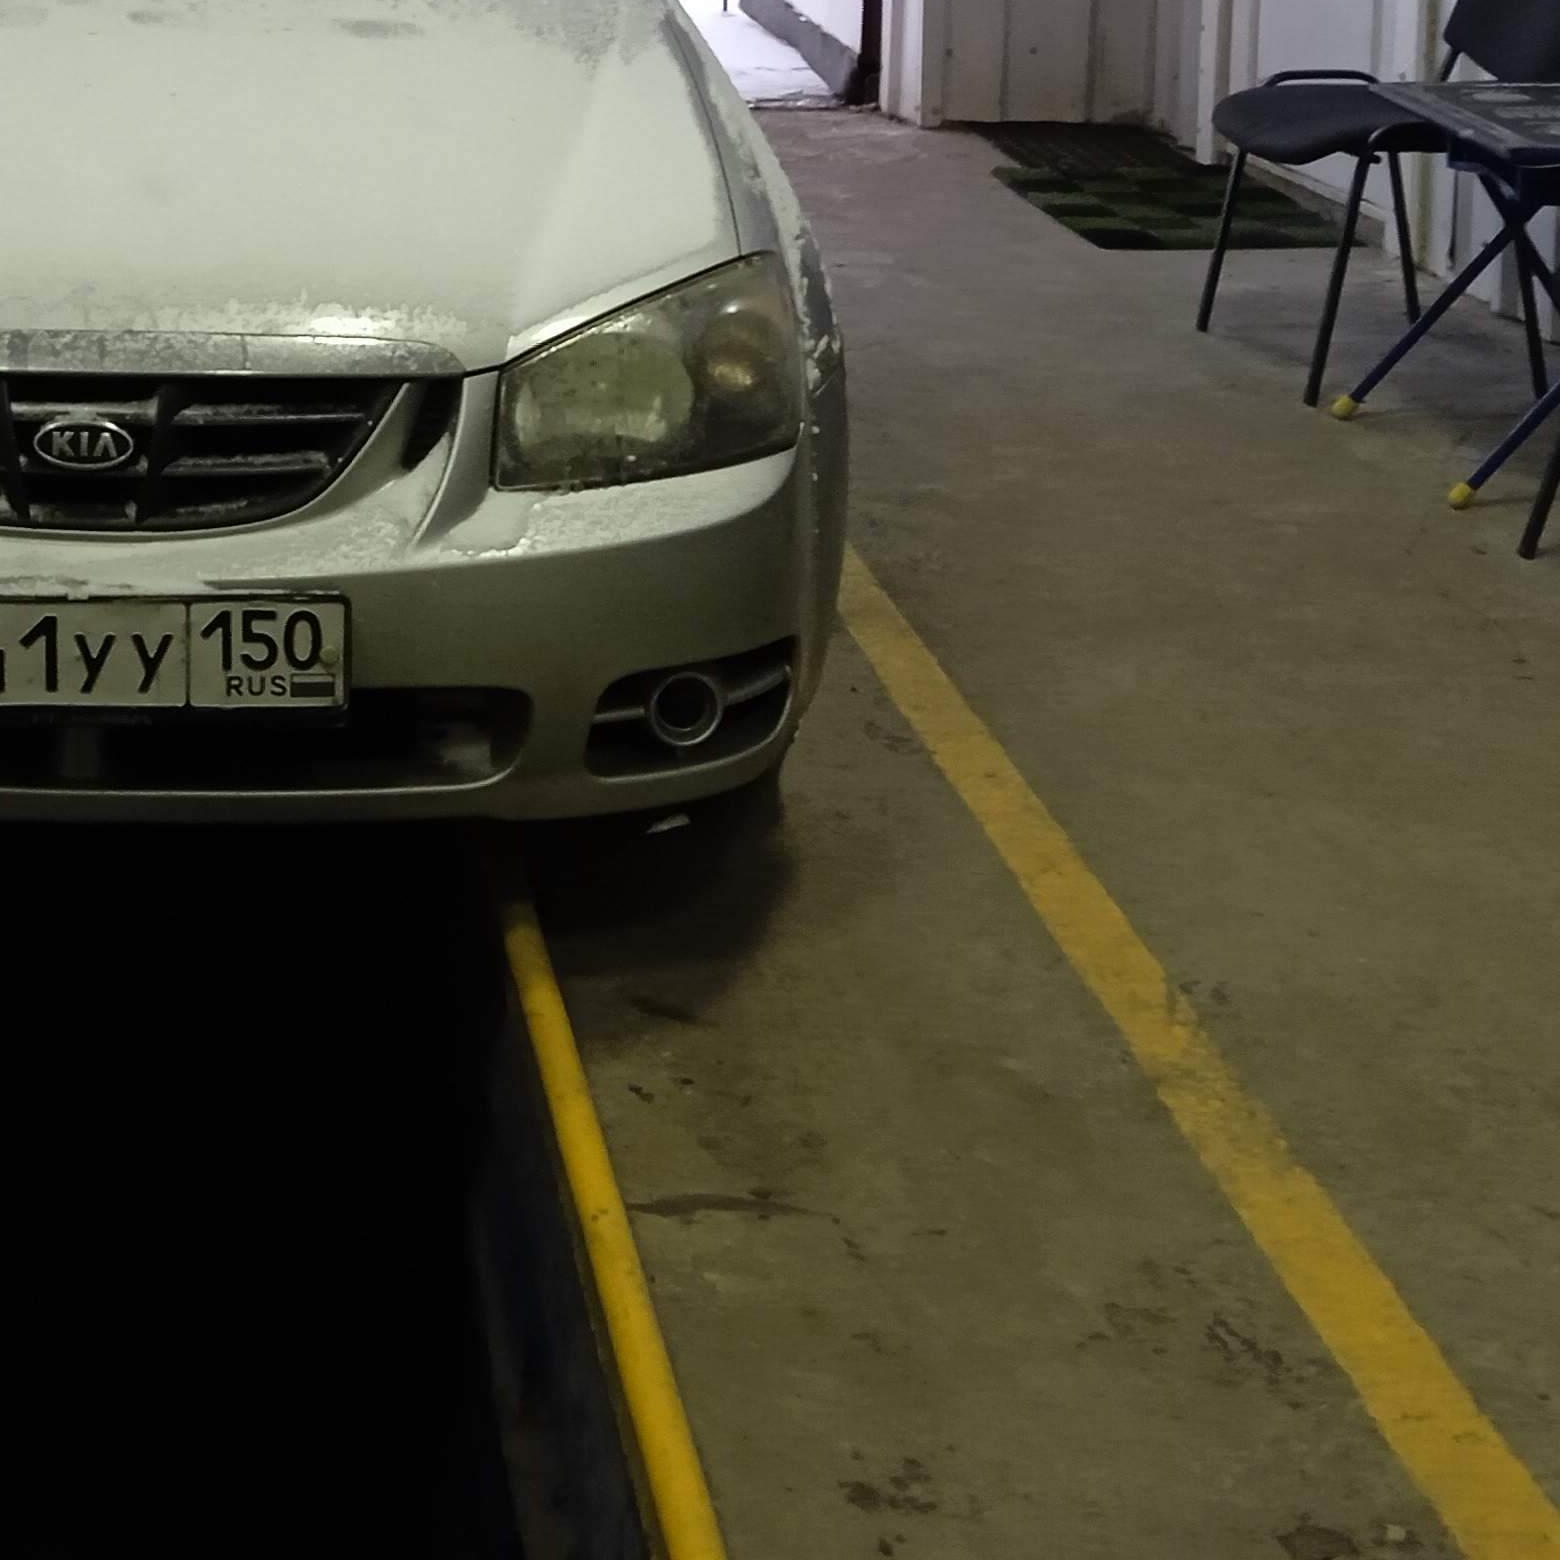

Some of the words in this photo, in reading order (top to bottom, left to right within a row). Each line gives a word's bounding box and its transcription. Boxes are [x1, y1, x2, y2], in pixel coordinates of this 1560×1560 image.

[51, 431, 118, 457] KIA
[201, 610, 322, 672] 150
[226, 676, 287, 697] RUS
